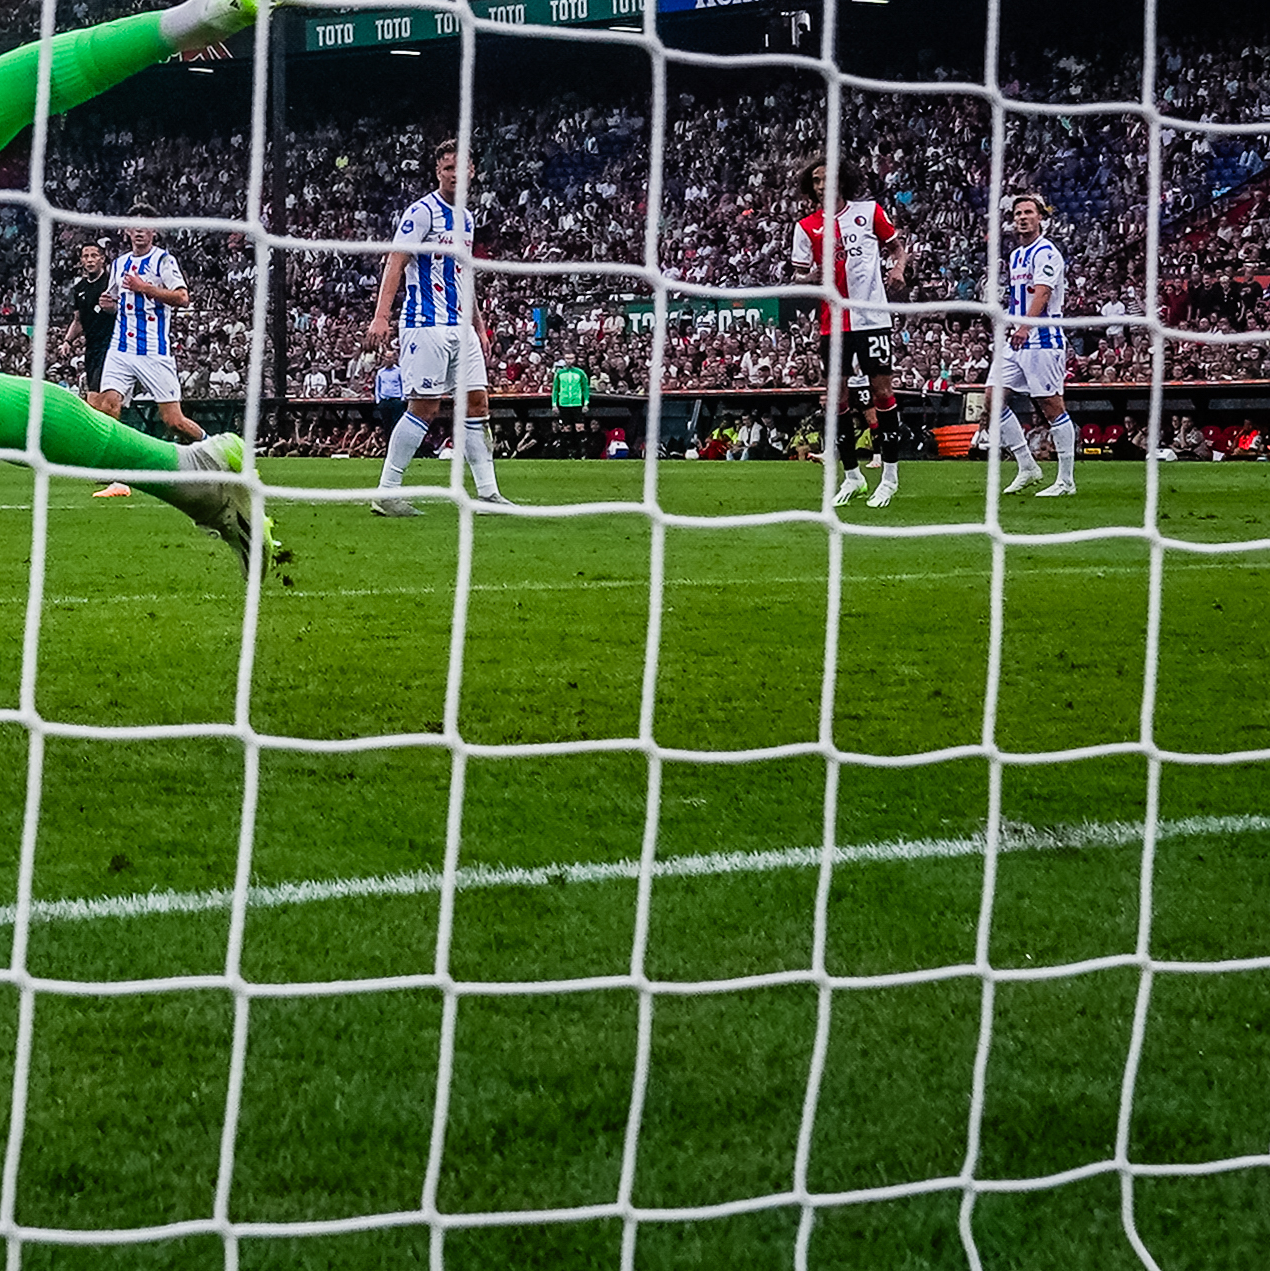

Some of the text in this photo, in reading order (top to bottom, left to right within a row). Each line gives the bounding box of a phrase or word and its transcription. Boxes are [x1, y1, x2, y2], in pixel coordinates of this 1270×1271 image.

[435, 13, 460, 35] TOT
[488, 4, 525, 24] TOTO
[316, 23, 354, 47] TOTO
[375, 17, 412, 41] TOTO
[868, 335, 891, 358] 24
